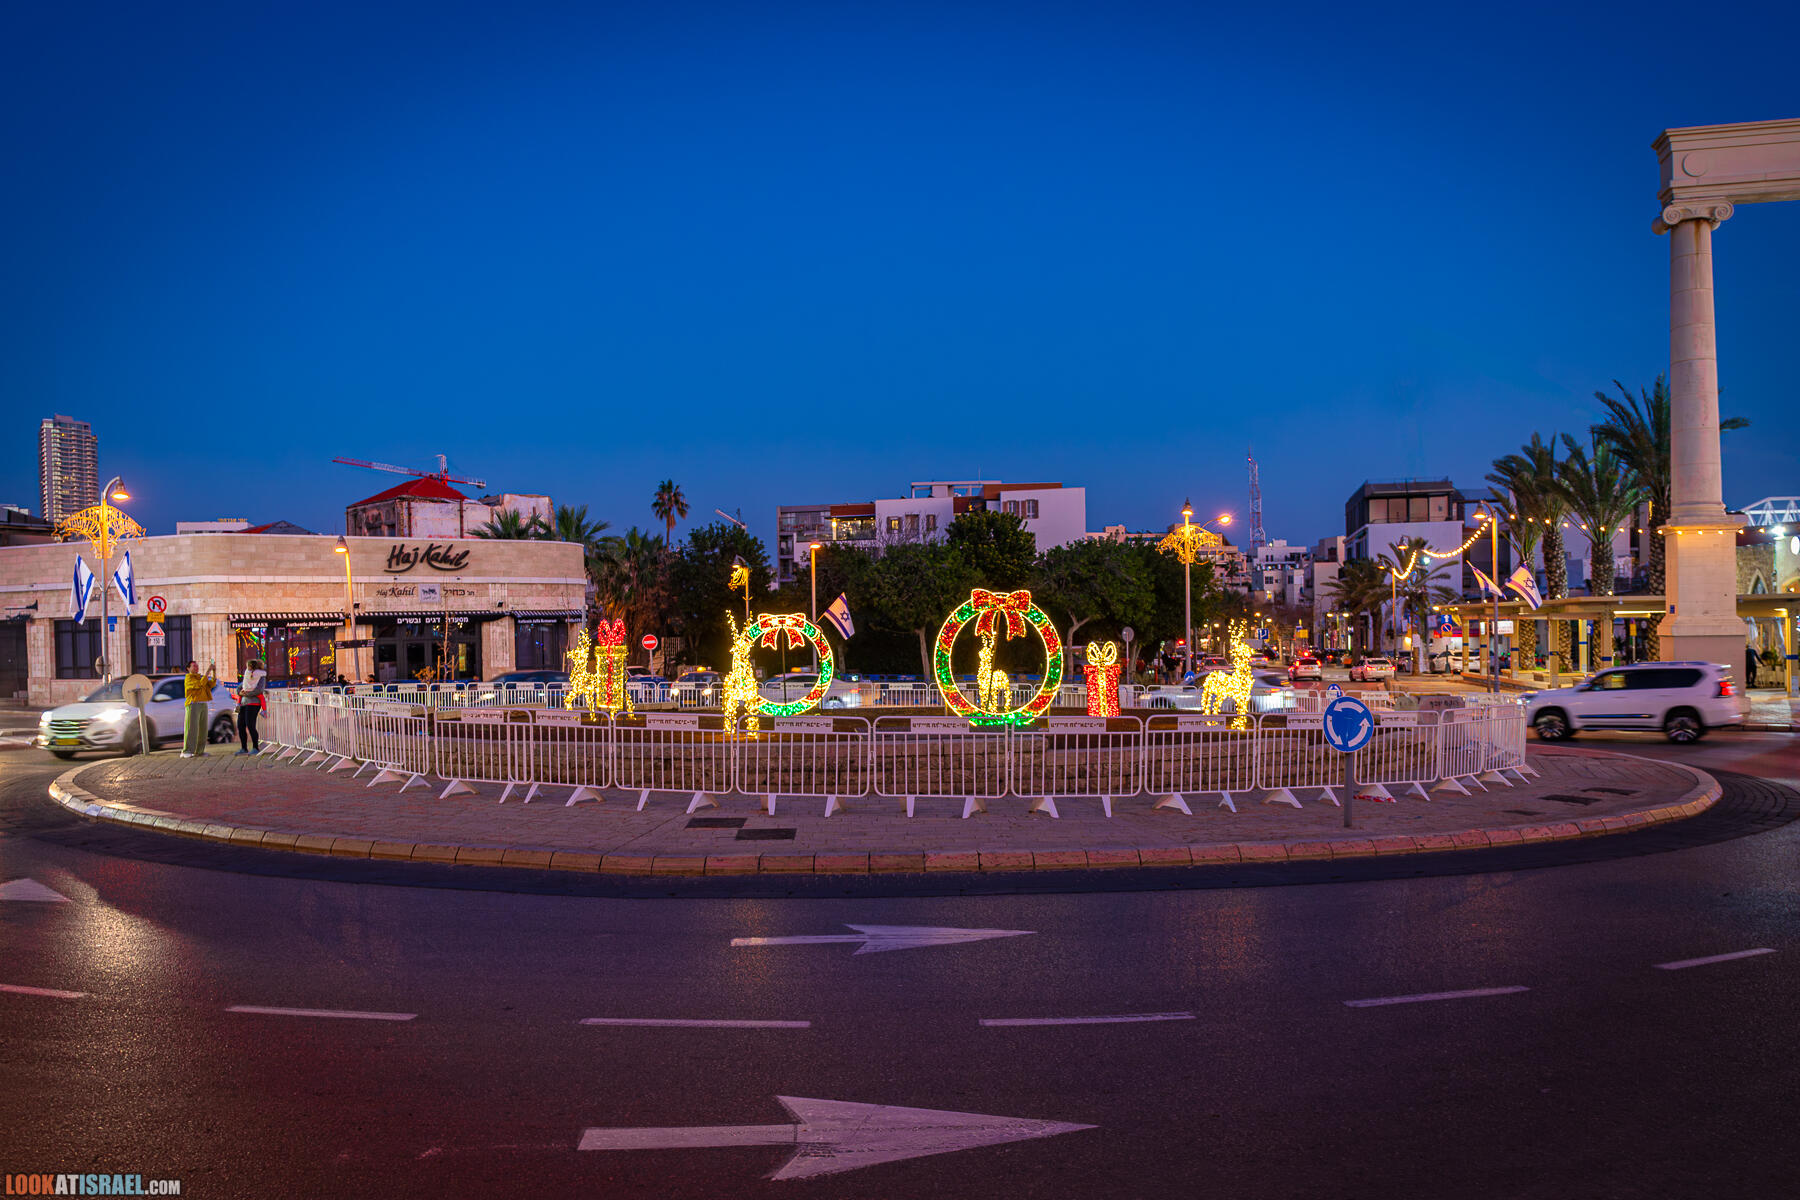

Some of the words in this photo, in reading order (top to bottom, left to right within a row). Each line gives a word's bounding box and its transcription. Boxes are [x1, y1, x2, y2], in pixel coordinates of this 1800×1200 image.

[384, 543, 419, 573] Haj
[420, 543, 470, 571] Kahil
[376, 589, 387, 598] Haj
[388, 586, 416, 597] Kahil
[443, 586, 465, 596] כחיל
